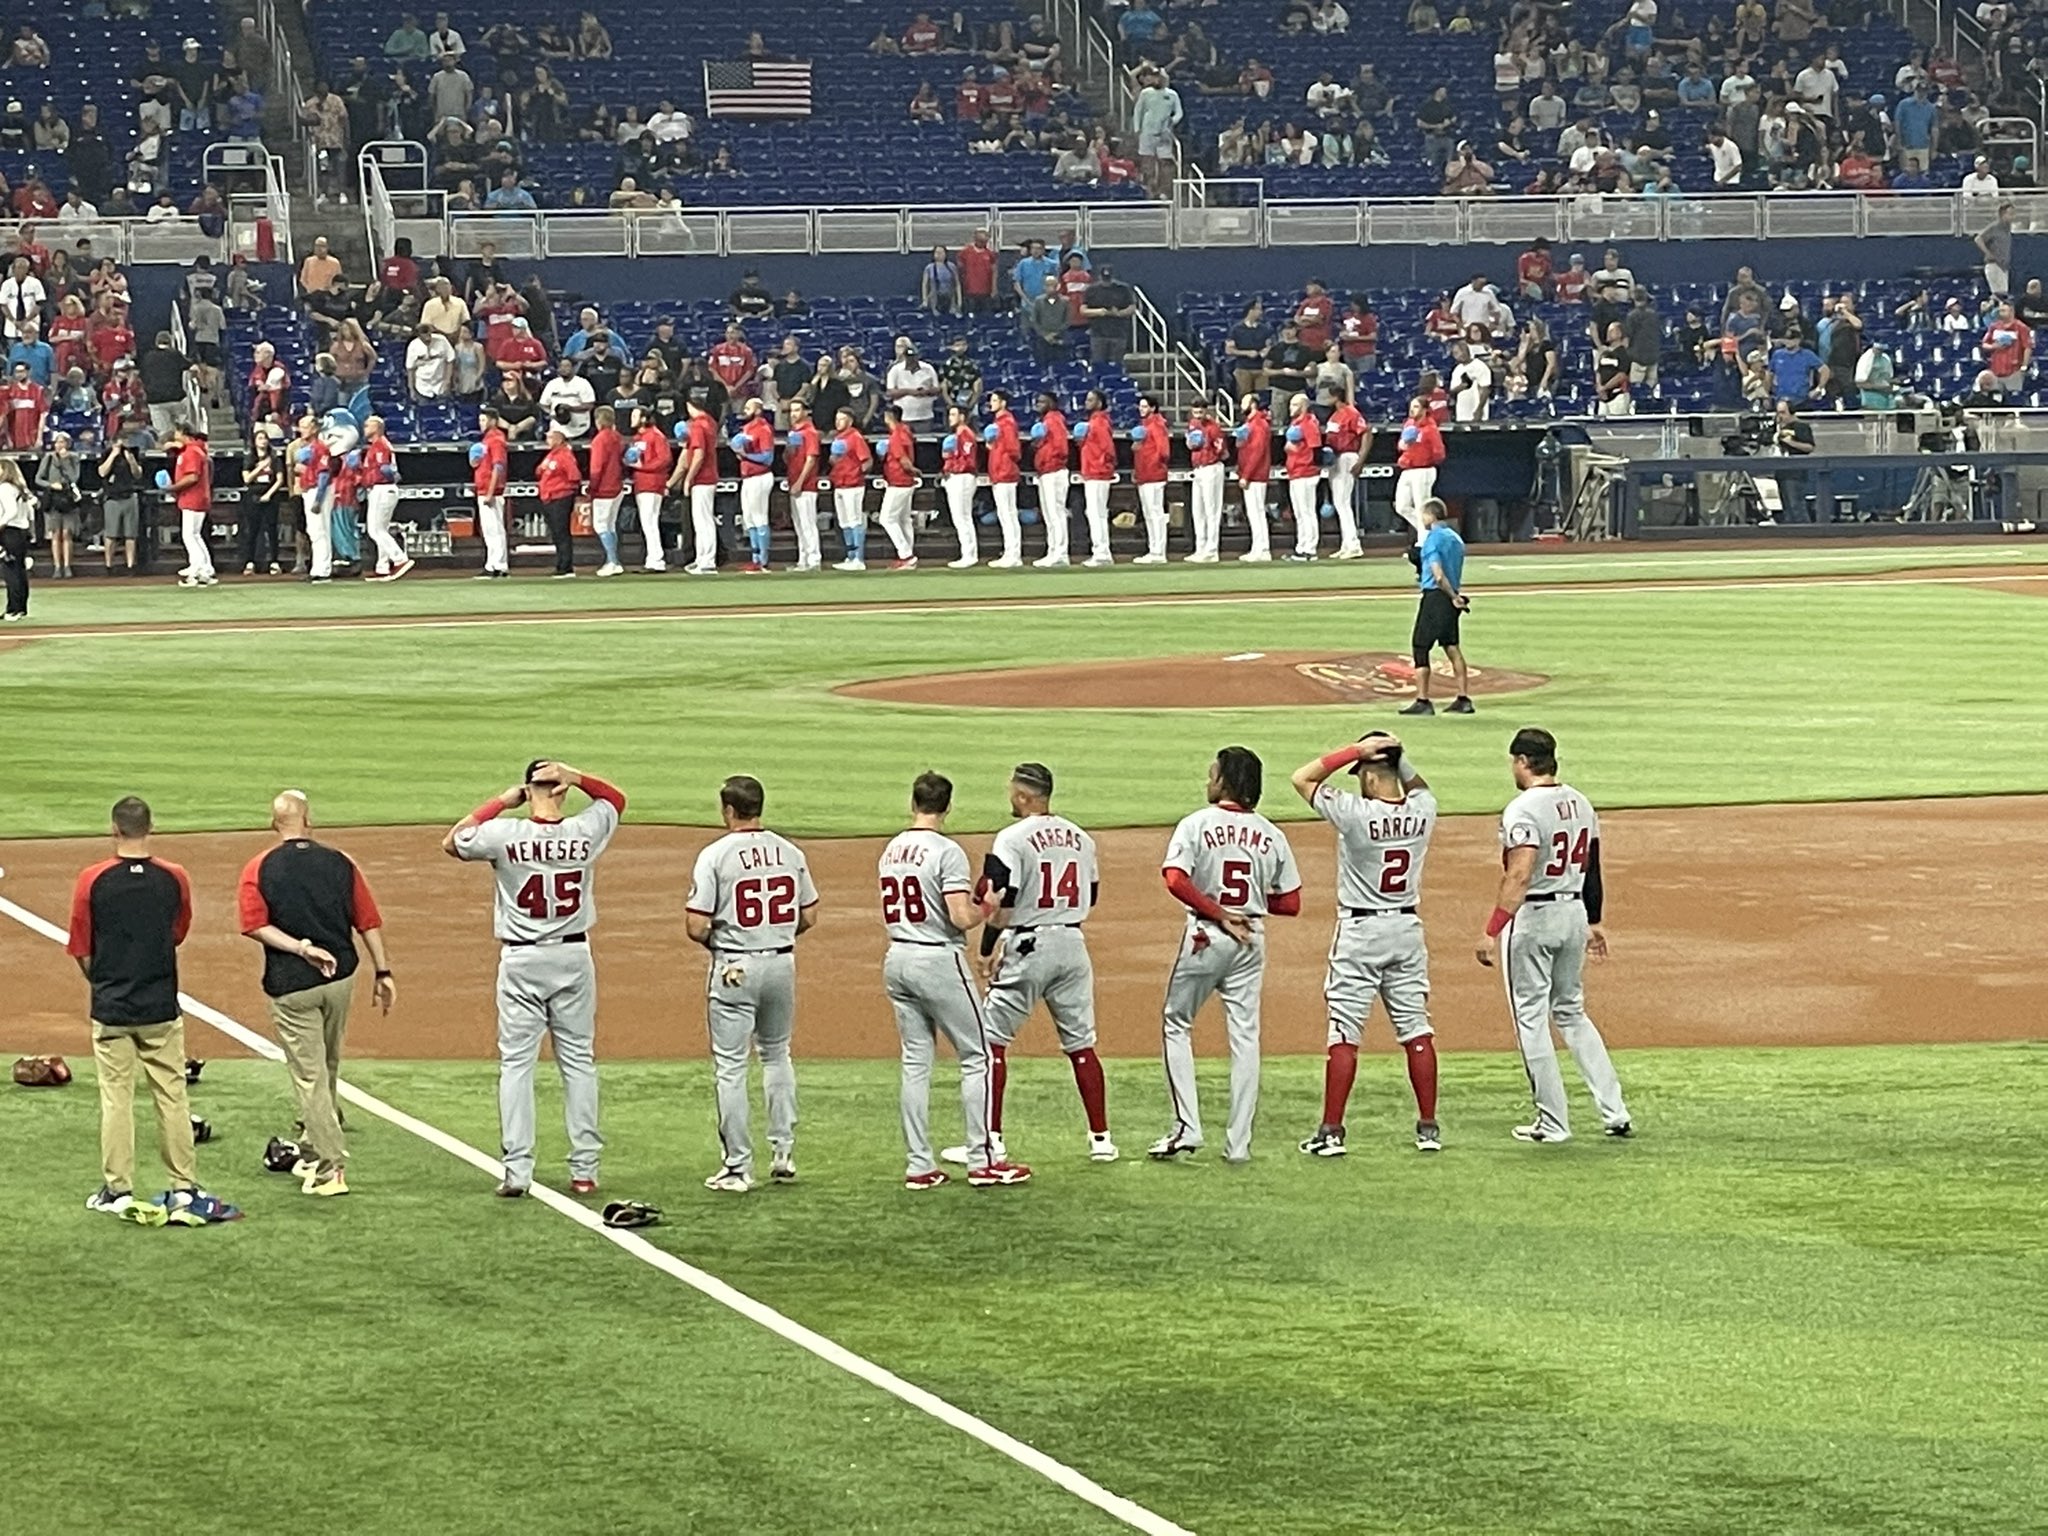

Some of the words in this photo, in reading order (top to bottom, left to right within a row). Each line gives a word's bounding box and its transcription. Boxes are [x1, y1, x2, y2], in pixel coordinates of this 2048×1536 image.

[738, 846, 784, 870] CALL
[1027, 827, 1082, 853] VARGAS
[1203, 824, 1273, 855] ABRAMS
[1545, 827, 1589, 876] 34
[1038, 861, 1079, 908] 14
[1219, 860, 1251, 906] 5
[1379, 849, 1411, 893] 2
[516, 870, 583, 919] 45
[735, 875, 795, 928] 62
[880, 875, 927, 924] 28
